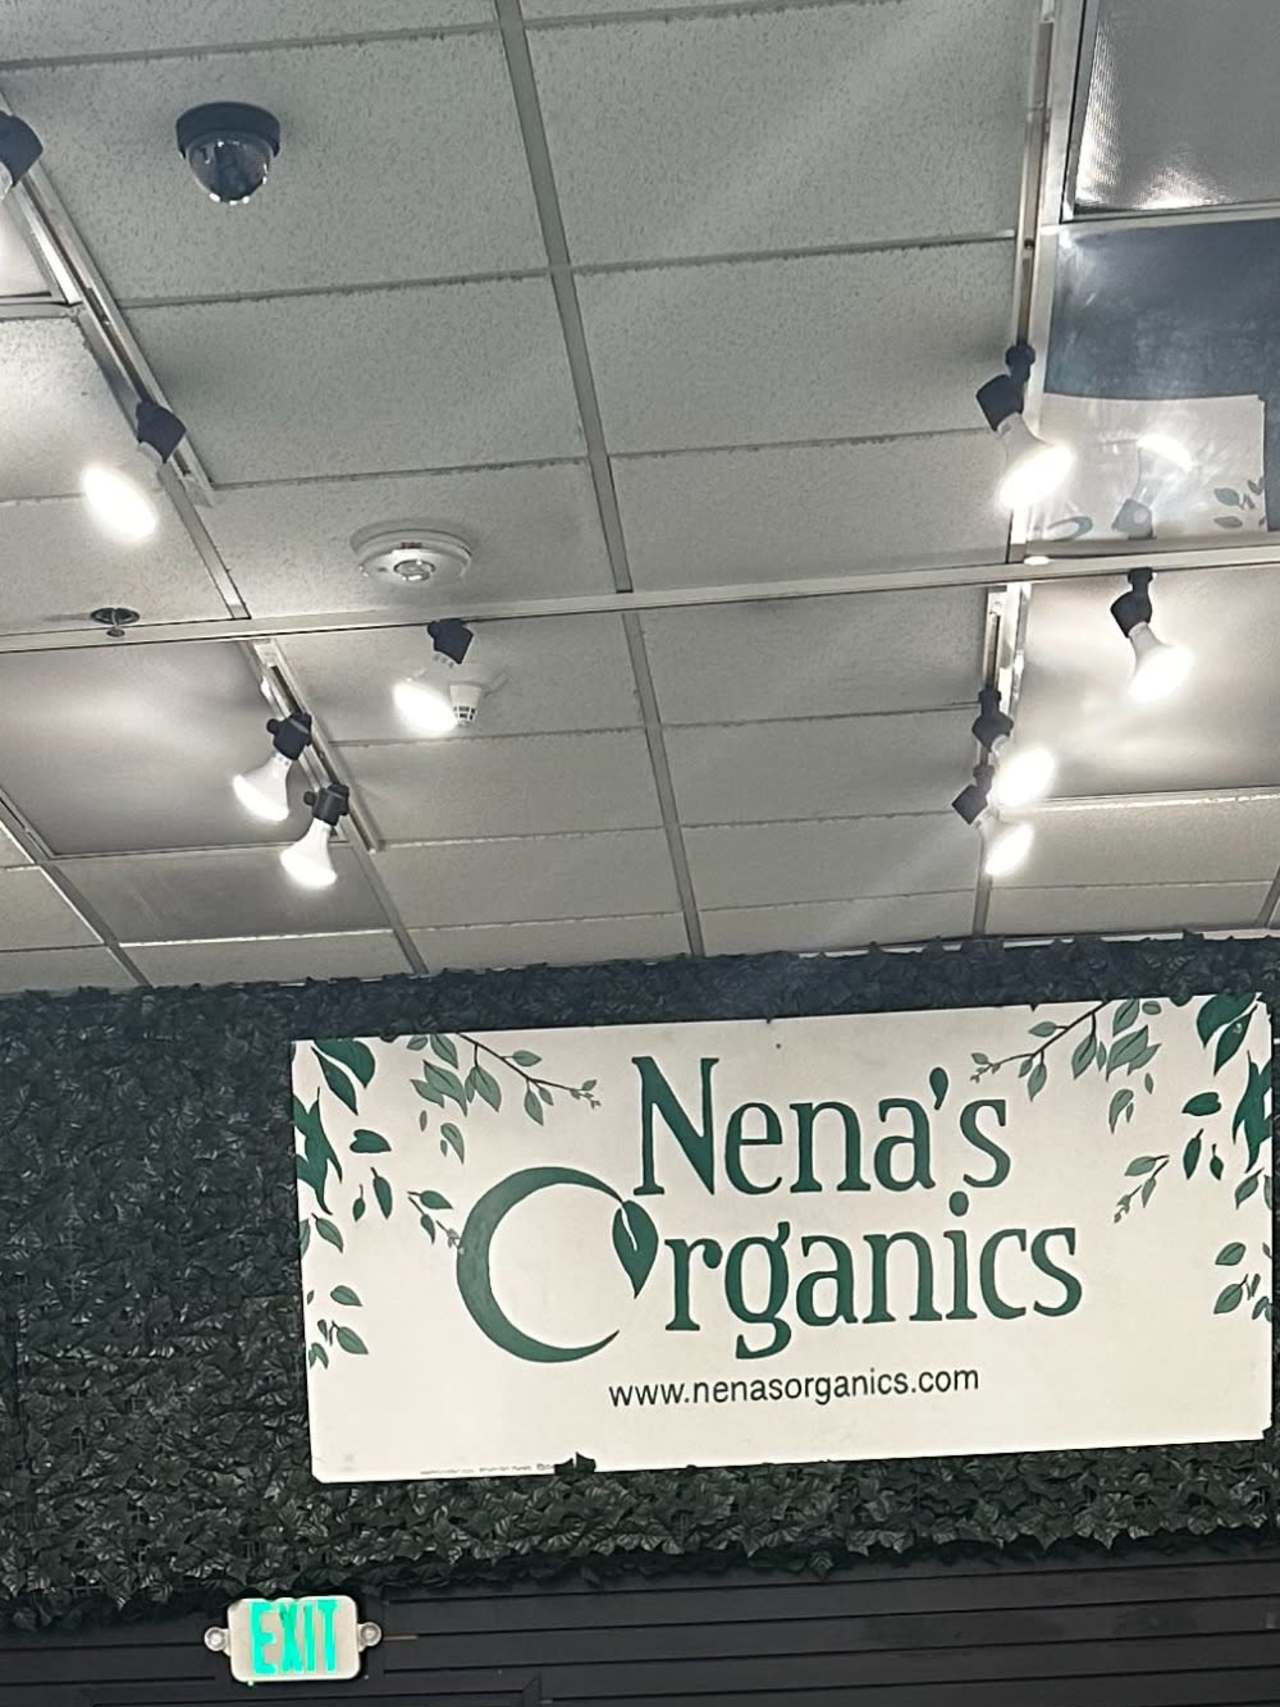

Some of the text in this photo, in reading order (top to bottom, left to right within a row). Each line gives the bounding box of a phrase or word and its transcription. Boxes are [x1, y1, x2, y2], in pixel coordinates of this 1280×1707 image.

[631, 1054, 1011, 1197] Nena's
[456, 1166, 1083, 1363] Organics
[608, 1363, 979, 1408] www.nenasorganics.com
[251, 1599, 338, 1675] EXIT
